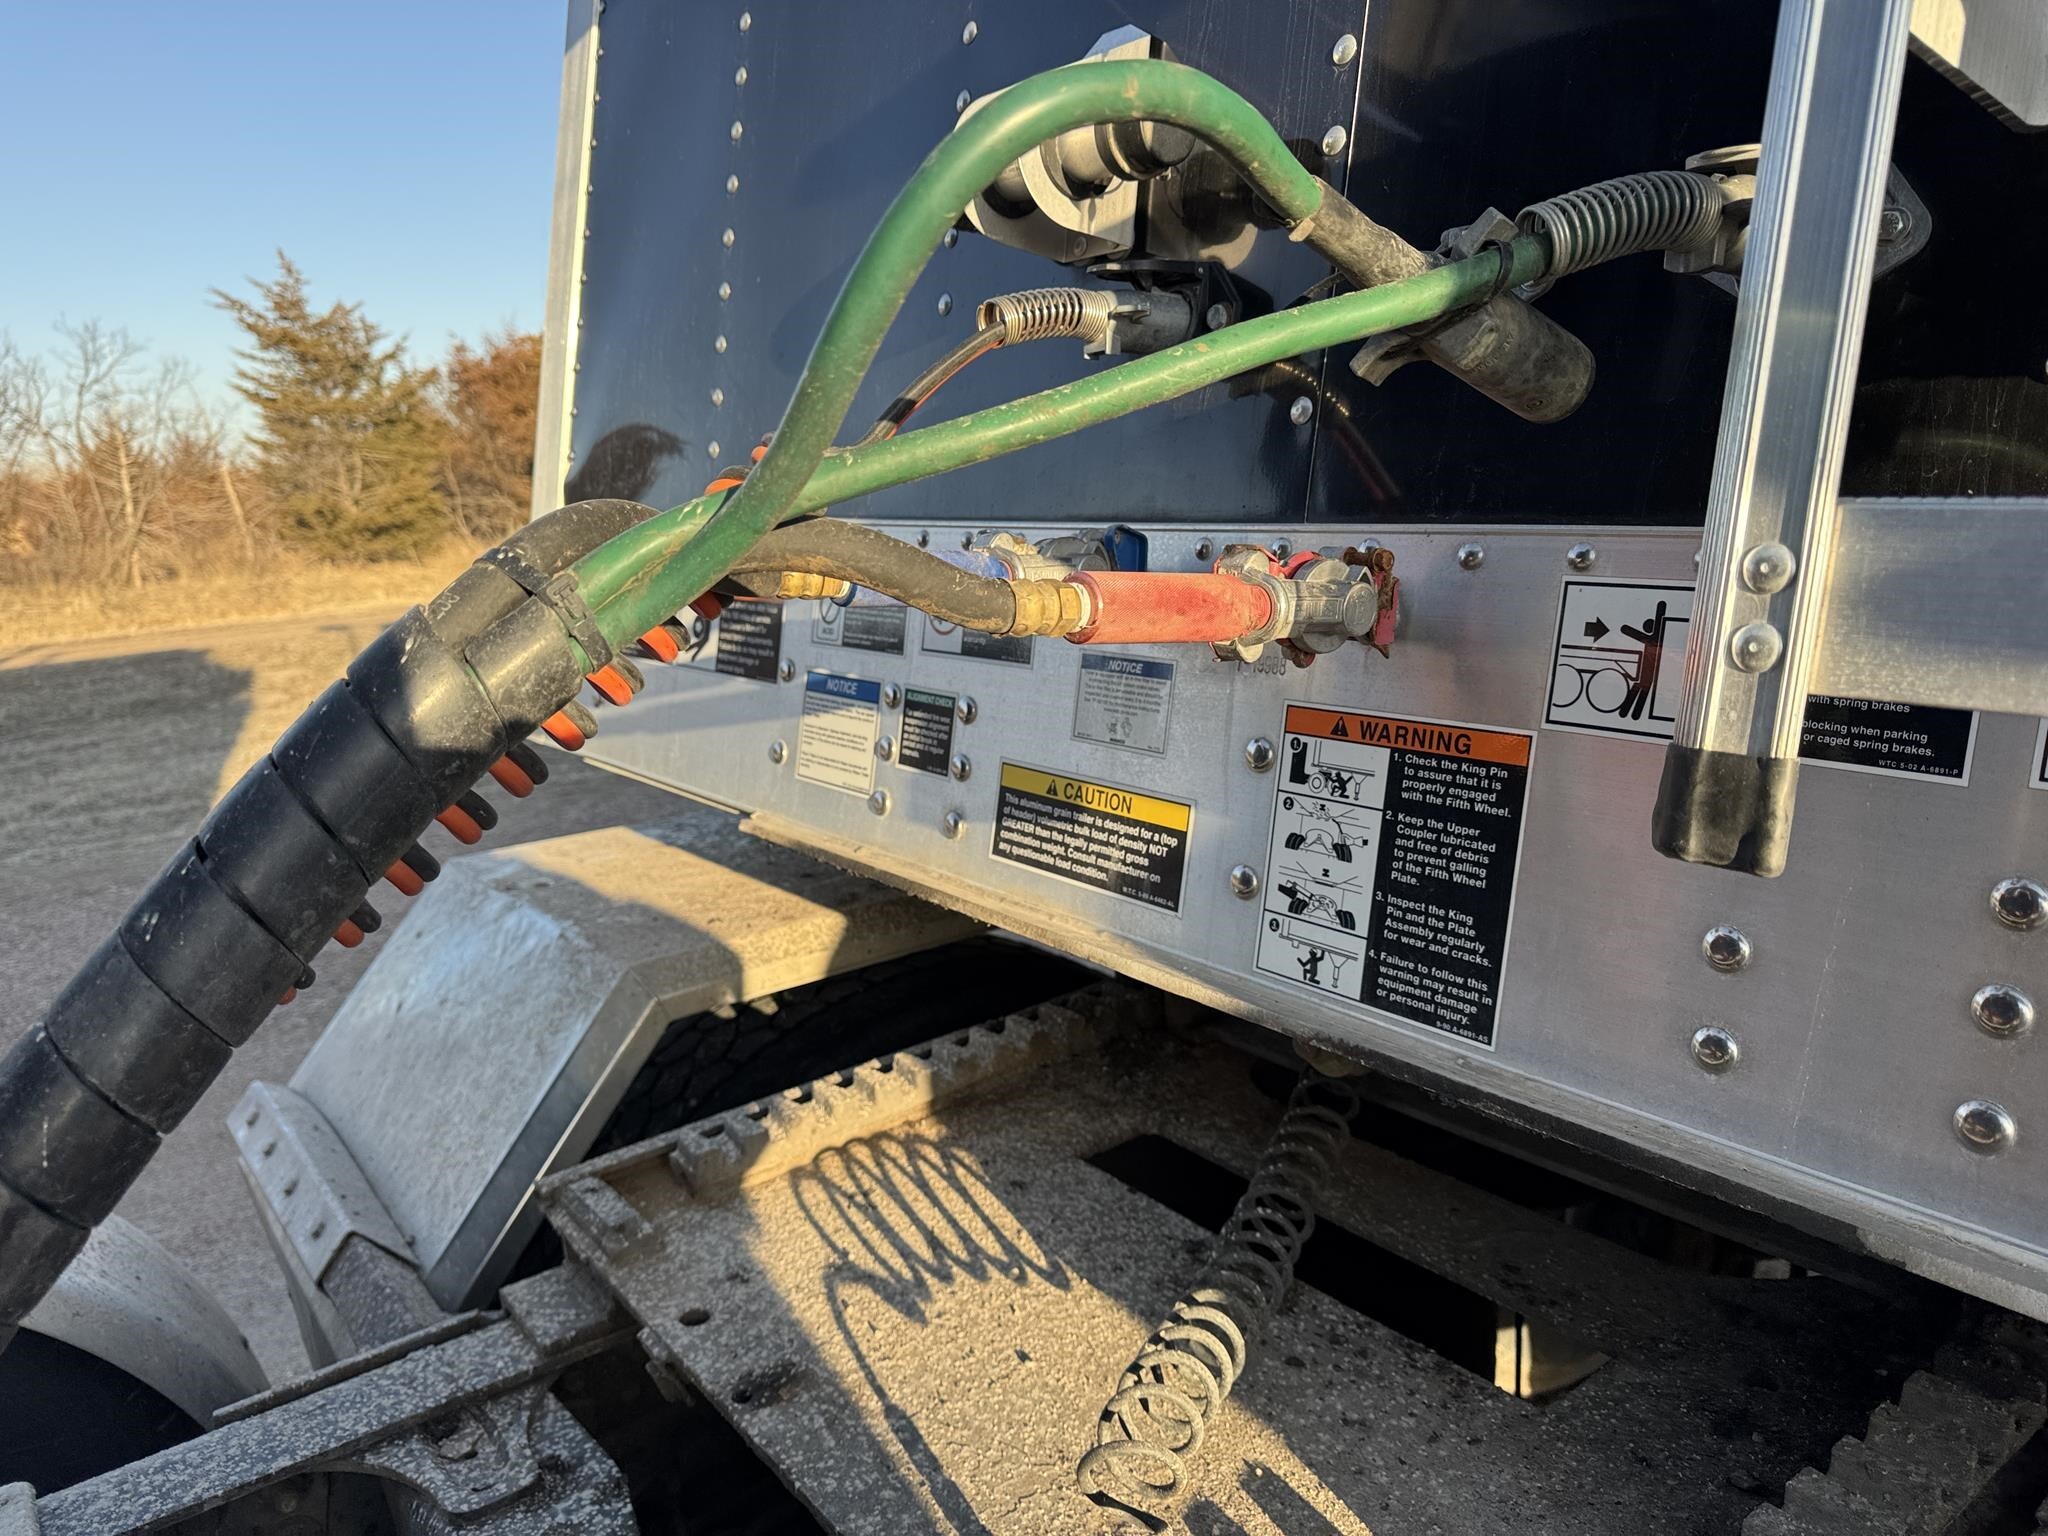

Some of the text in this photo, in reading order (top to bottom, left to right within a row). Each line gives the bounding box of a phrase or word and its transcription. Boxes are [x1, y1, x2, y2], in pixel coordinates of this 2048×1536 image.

[1108, 660, 1144, 674] NOTICE
[826, 679, 858, 696] NOTICE
[1808, 696, 1910, 712] with spring brakes
[1359, 720, 1472, 755] WARNING
[1818, 735, 1849, 746] caged
[1853, 739, 1889, 752] spring
[1893, 741, 1935, 757] brakes.
[1851, 725, 1880, 736] when
[1884, 730, 1928, 744] parking
[1394, 753, 1508, 778] 1. Check the King Pin
[1404, 766, 1501, 790] to assure that it is
[1879, 760, 1896, 768] WTC
[1064, 782, 1132, 814] CAUTION
[1401, 791, 1511, 817] with the Fifth Wheel.
[1402, 780, 1496, 802] properly engaged
[1003, 806, 1010, 814] of
[1037, 816, 1073, 832] volumetric
[1074, 824, 1090, 836] bulk
[1091, 828, 1108, 841] load
[1109, 834, 1118, 844] of
[1118, 836, 1148, 854] density
[1149, 844, 1168, 857] NOT
[1006, 793, 1019, 805] This
[1020, 798, 1052, 813] aluminum
[1053, 807, 1071, 818] grain
[1073, 811, 1095, 824] trailer
[1095, 816, 1102, 826] is
[1104, 819, 1140, 836] designed
[1140, 828, 1153, 839] for
[1160, 833, 1178, 848] (top
[1386, 811, 1480, 836] 2. Keep the Upper
[1002, 817, 1149, 866] GREATER than the legally permitted gross
[1395, 838, 1489, 864] and free of debris
[1397, 824, 1496, 852] Coupler lubricated
[999, 842, 1109, 881] any questionable load condition.
[1000, 830, 1040, 848] combination
[1068, 848, 1096, 865] Consult
[1097, 857, 1149, 880] manufacturer
[1150, 874, 1160, 883] on
[1394, 848, 1487, 878] to prevent galling
[1391, 871, 1420, 886] Plate.
[1392, 861, 1486, 888] of the Fifth Wheel
[1376, 891, 1473, 925] 3. Inspect the King
[1386, 906, 1476, 937] Pin and the Plate
[1384, 930, 1492, 967] for wear and cracks.
[1385, 918, 1486, 953] Assembly regularly
[1369, 949, 1488, 991] 4. Failure to follow this
[1380, 965, 1493, 1005] warning may result in
[1376, 989, 1470, 1025] or personal injury.
[1378, 977, 1477, 1014] equipment damage
